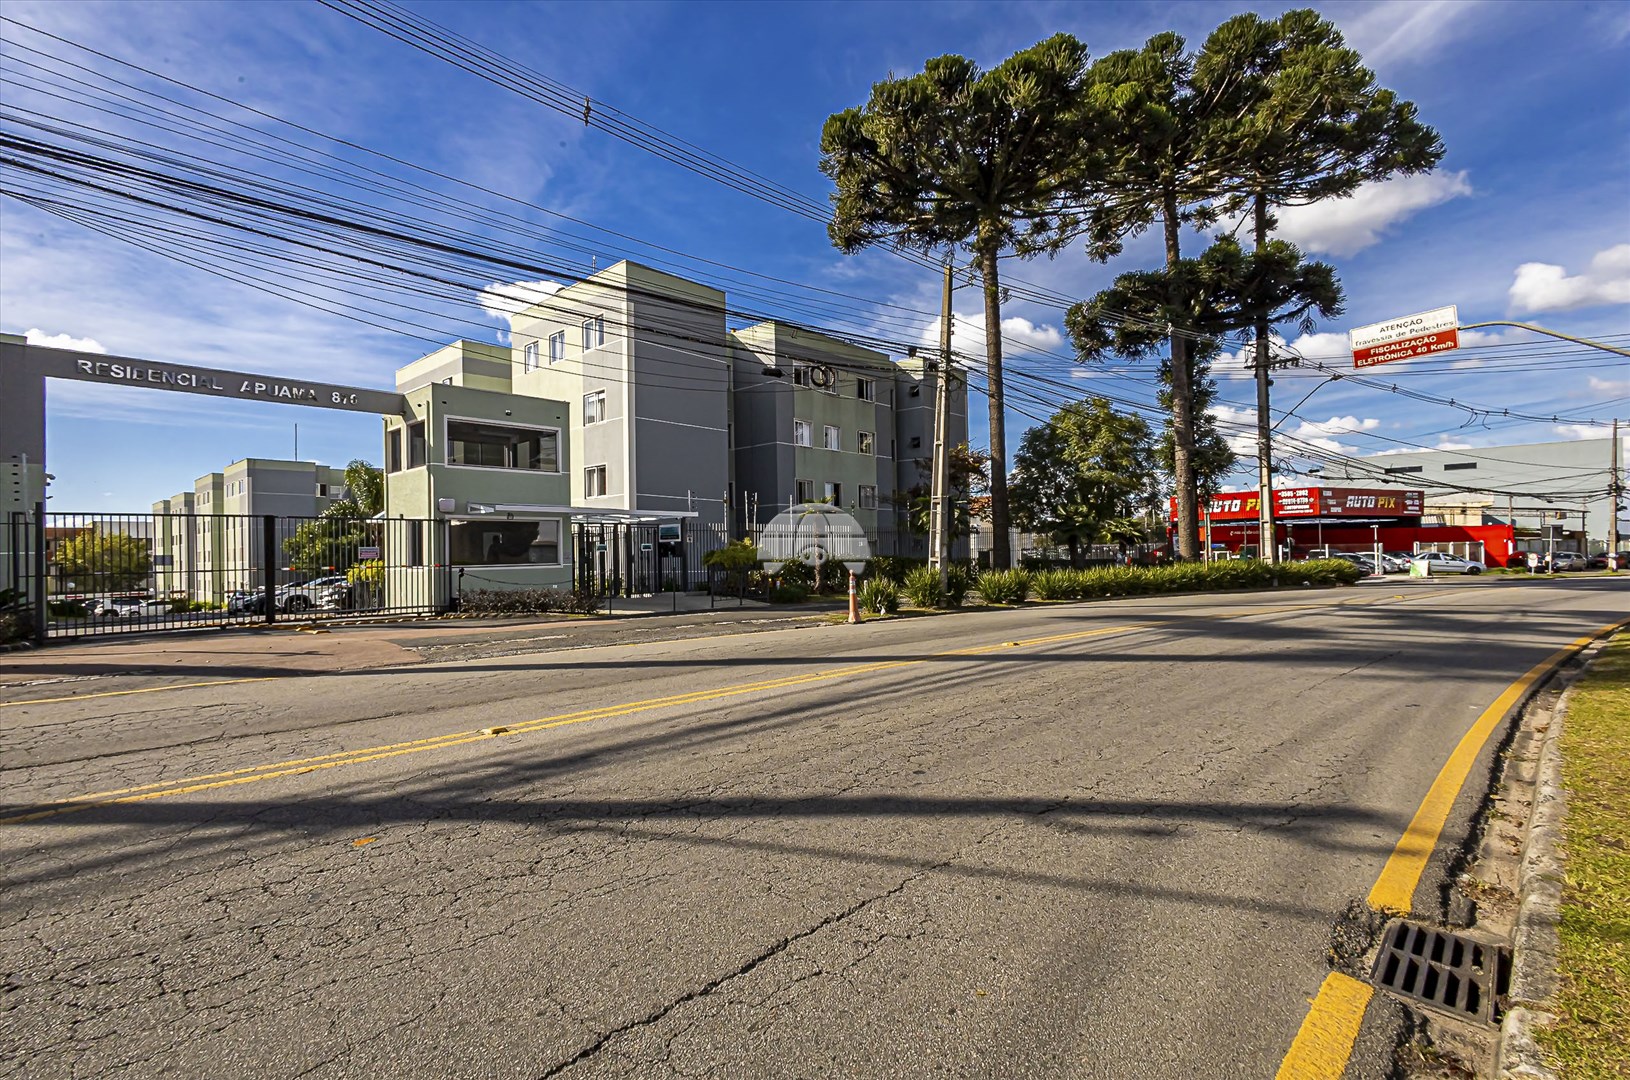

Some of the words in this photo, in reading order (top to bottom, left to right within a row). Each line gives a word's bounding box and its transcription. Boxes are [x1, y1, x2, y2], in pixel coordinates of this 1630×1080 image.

[1355, 334, 1393, 347] Travessia
[1409, 321, 1454, 334] Pedestres
[1357, 349, 1414, 367] ELETRÔNICA
[1416, 346, 1428, 354] 40
[1430, 341, 1455, 351] Km/h
[77, 359, 224, 391] RESIDENCIAL
[240, 380, 318, 402] APUAMA
[1246, 498, 1261, 511] PI
[1347, 495, 1376, 508] AUTO
[1377, 496, 1396, 509] PIX
